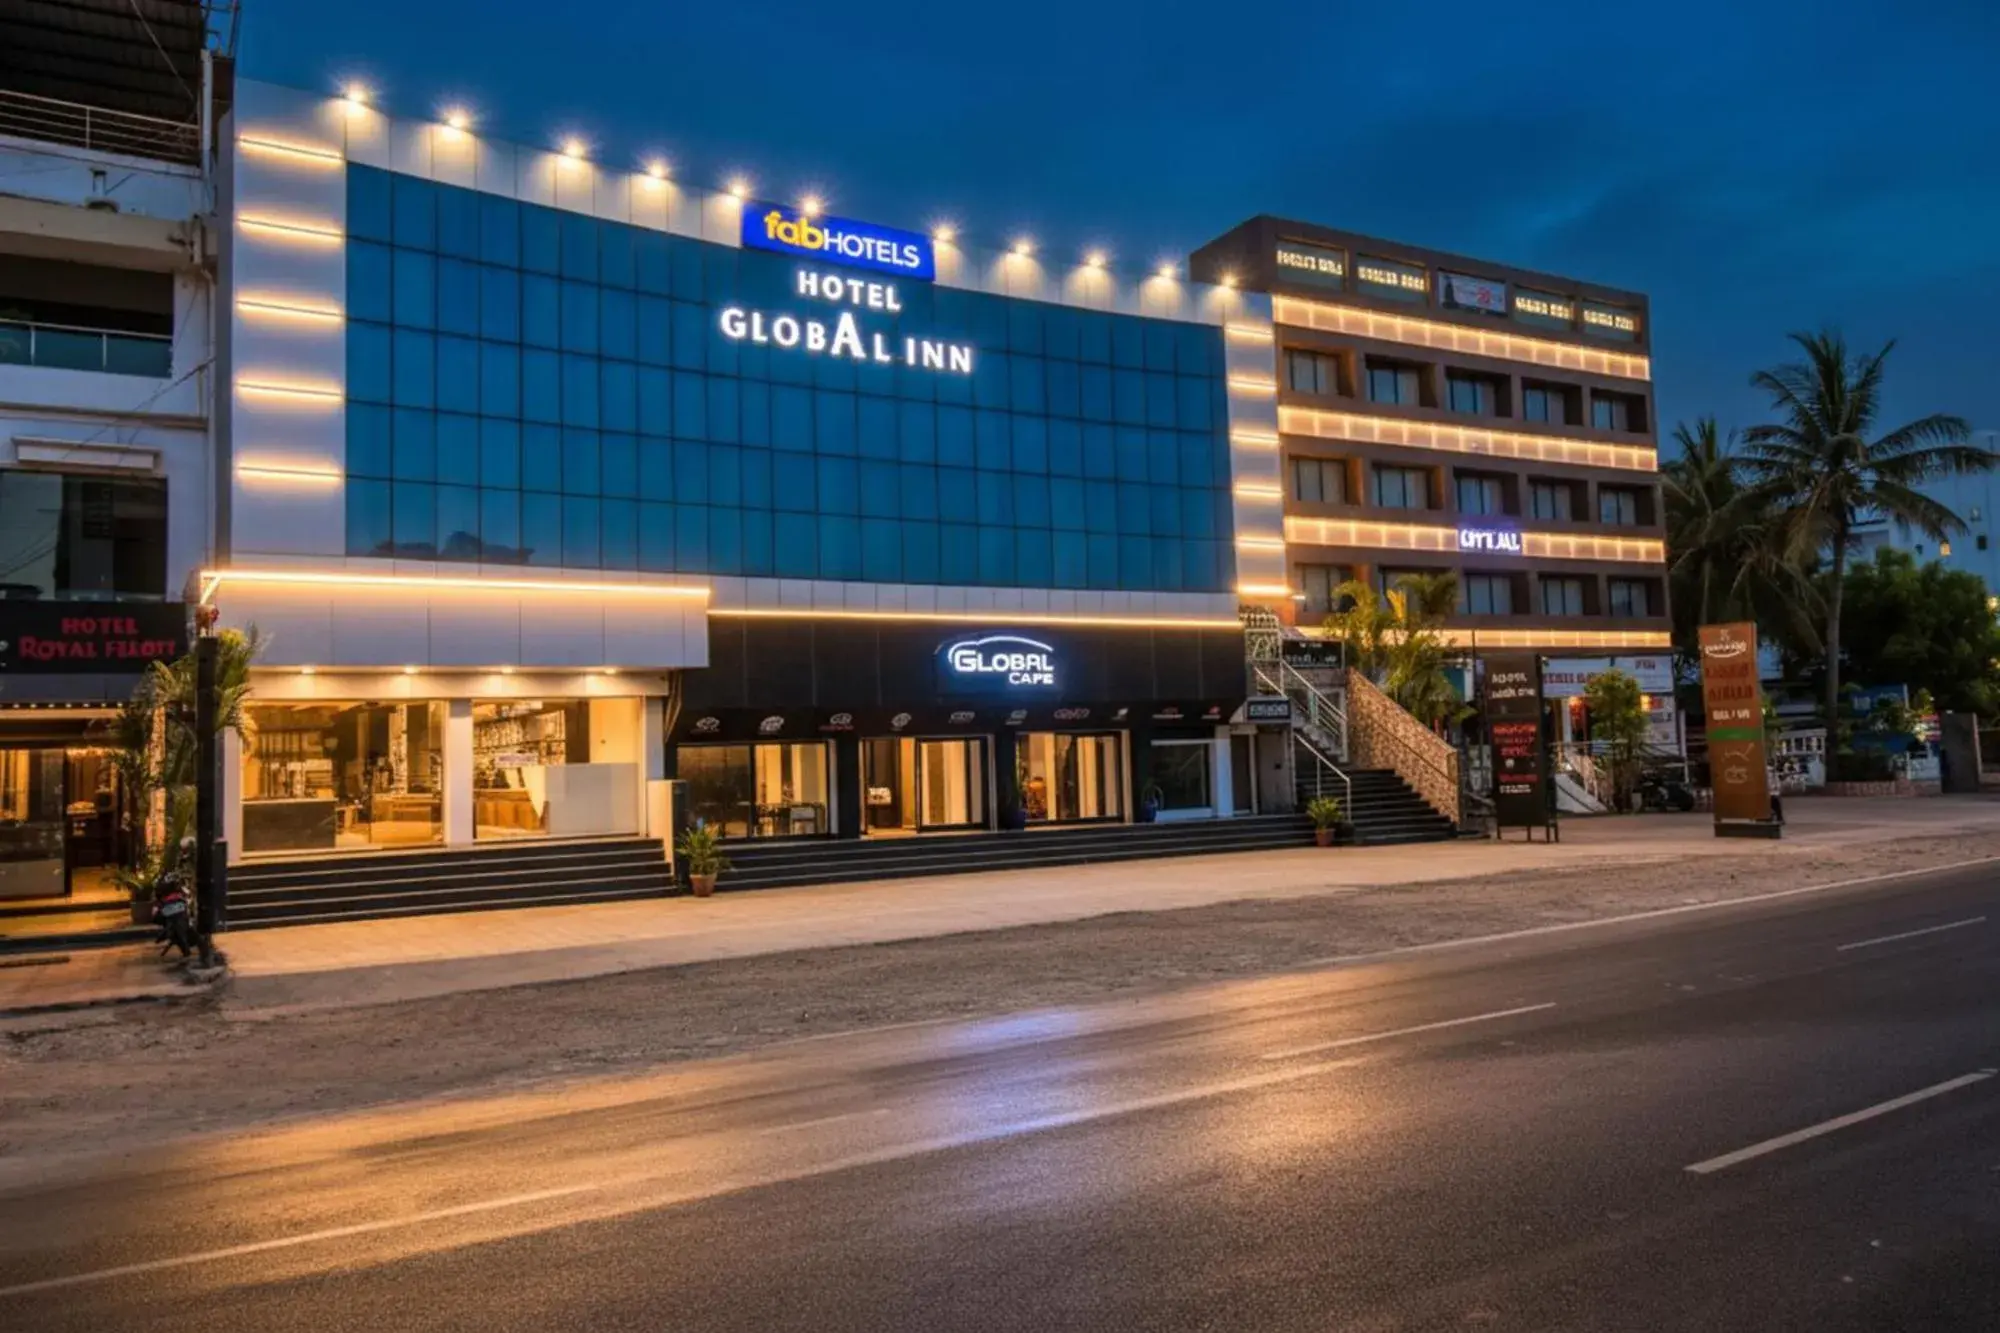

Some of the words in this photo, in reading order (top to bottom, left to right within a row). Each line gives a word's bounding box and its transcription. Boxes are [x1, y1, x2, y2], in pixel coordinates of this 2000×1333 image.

[764, 211, 921, 268] fabHOTELS
[798, 270, 902, 311] HOTEL
[720, 307, 891, 361] GLOBAL
[906, 337, 972, 373] INN
[61, 617, 139, 634] HOTEL
[19, 636, 97, 660] ROYAL
[954, 649, 1055, 672] GLOBAL
[1008, 672, 1054, 685] CAFE
